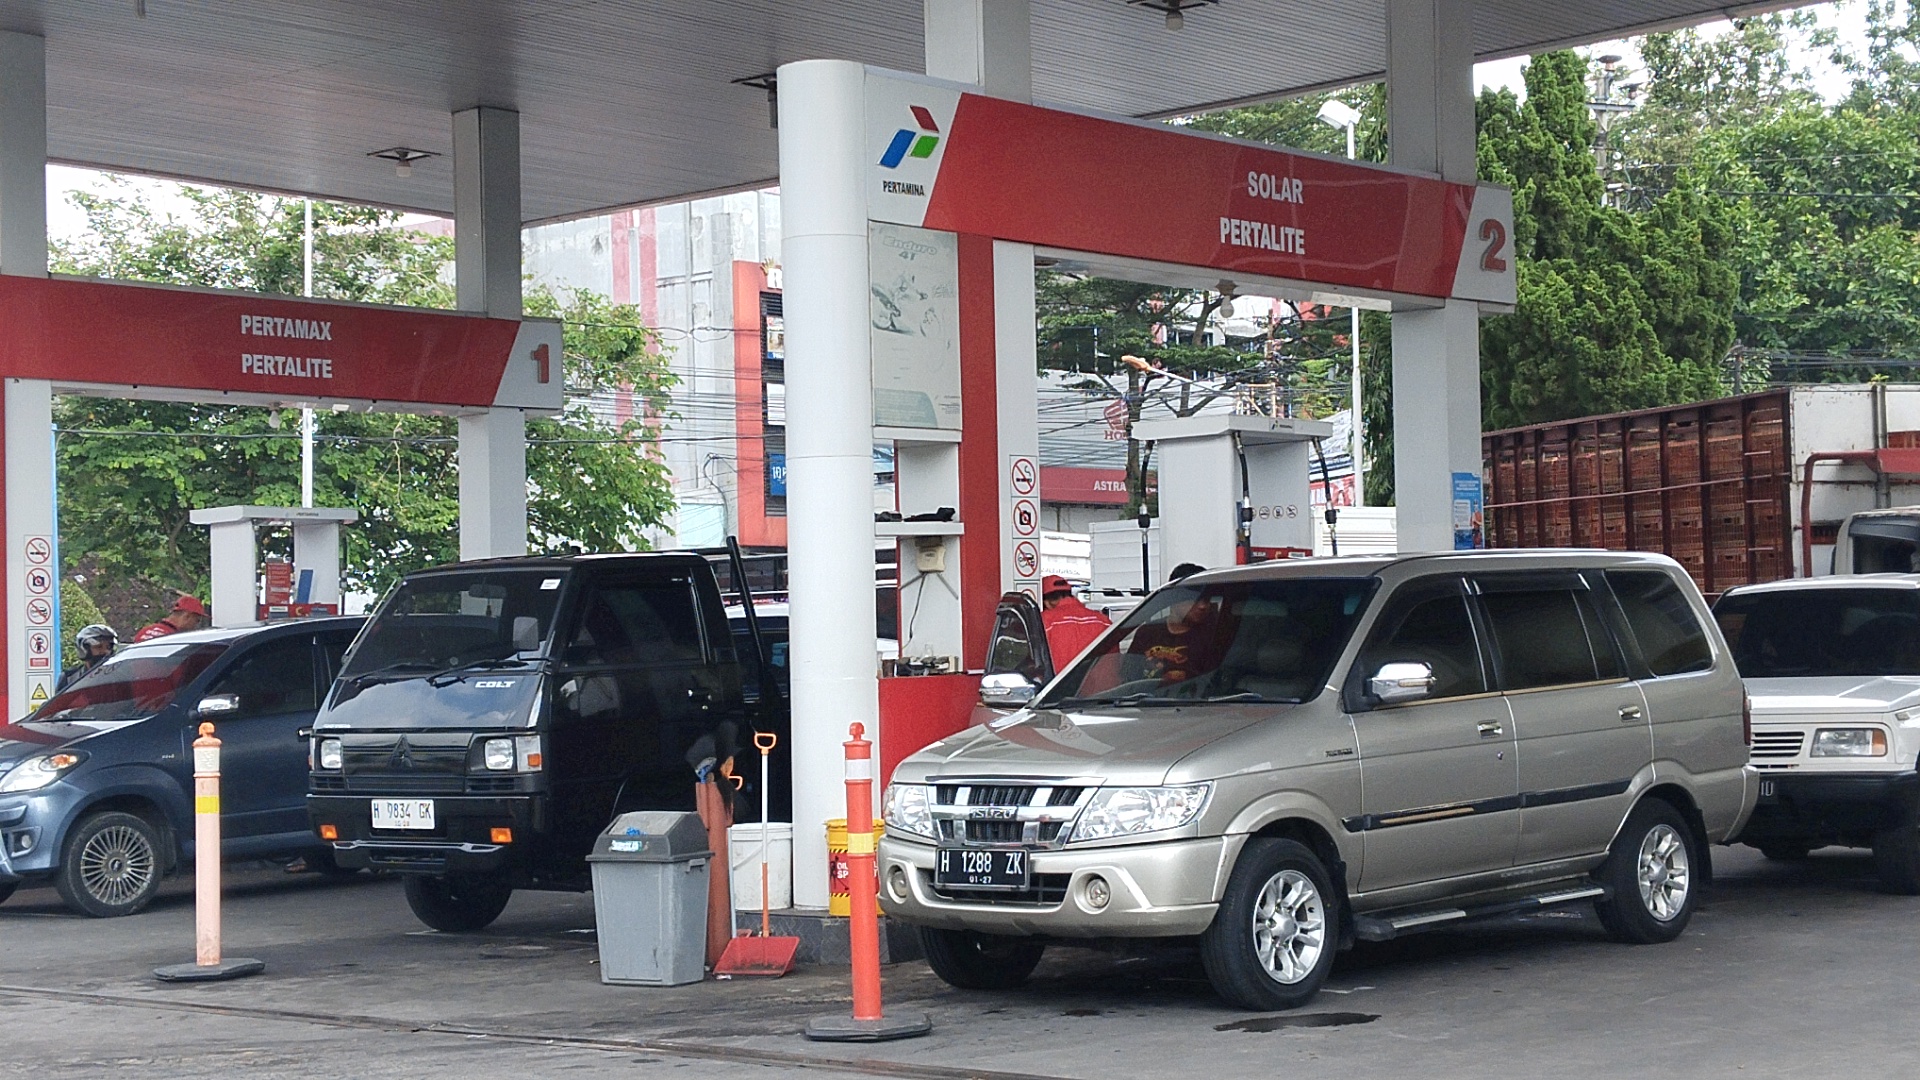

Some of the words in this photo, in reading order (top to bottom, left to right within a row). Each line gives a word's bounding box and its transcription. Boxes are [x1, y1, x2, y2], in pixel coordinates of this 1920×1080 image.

[882, 180, 926, 197] PERTAMINA
[1247, 171, 1304, 204] SOLAR
[1219, 216, 1306, 255] PERTALITE
[1479, 218, 1507, 274] 2
[240, 314, 332, 341] PERTAMAX
[241, 353, 333, 379] PERTALITE
[530, 343, 550, 384] 1
[1093, 480, 1127, 492] ASTRA
[474, 680, 516, 688] COLT
[373, 802, 380, 819] H
[969, 808, 1015, 819] ISUZU
[940, 851, 951, 873] H
[961, 851, 993, 874] 1288
[1005, 852, 1023, 875] ZK
